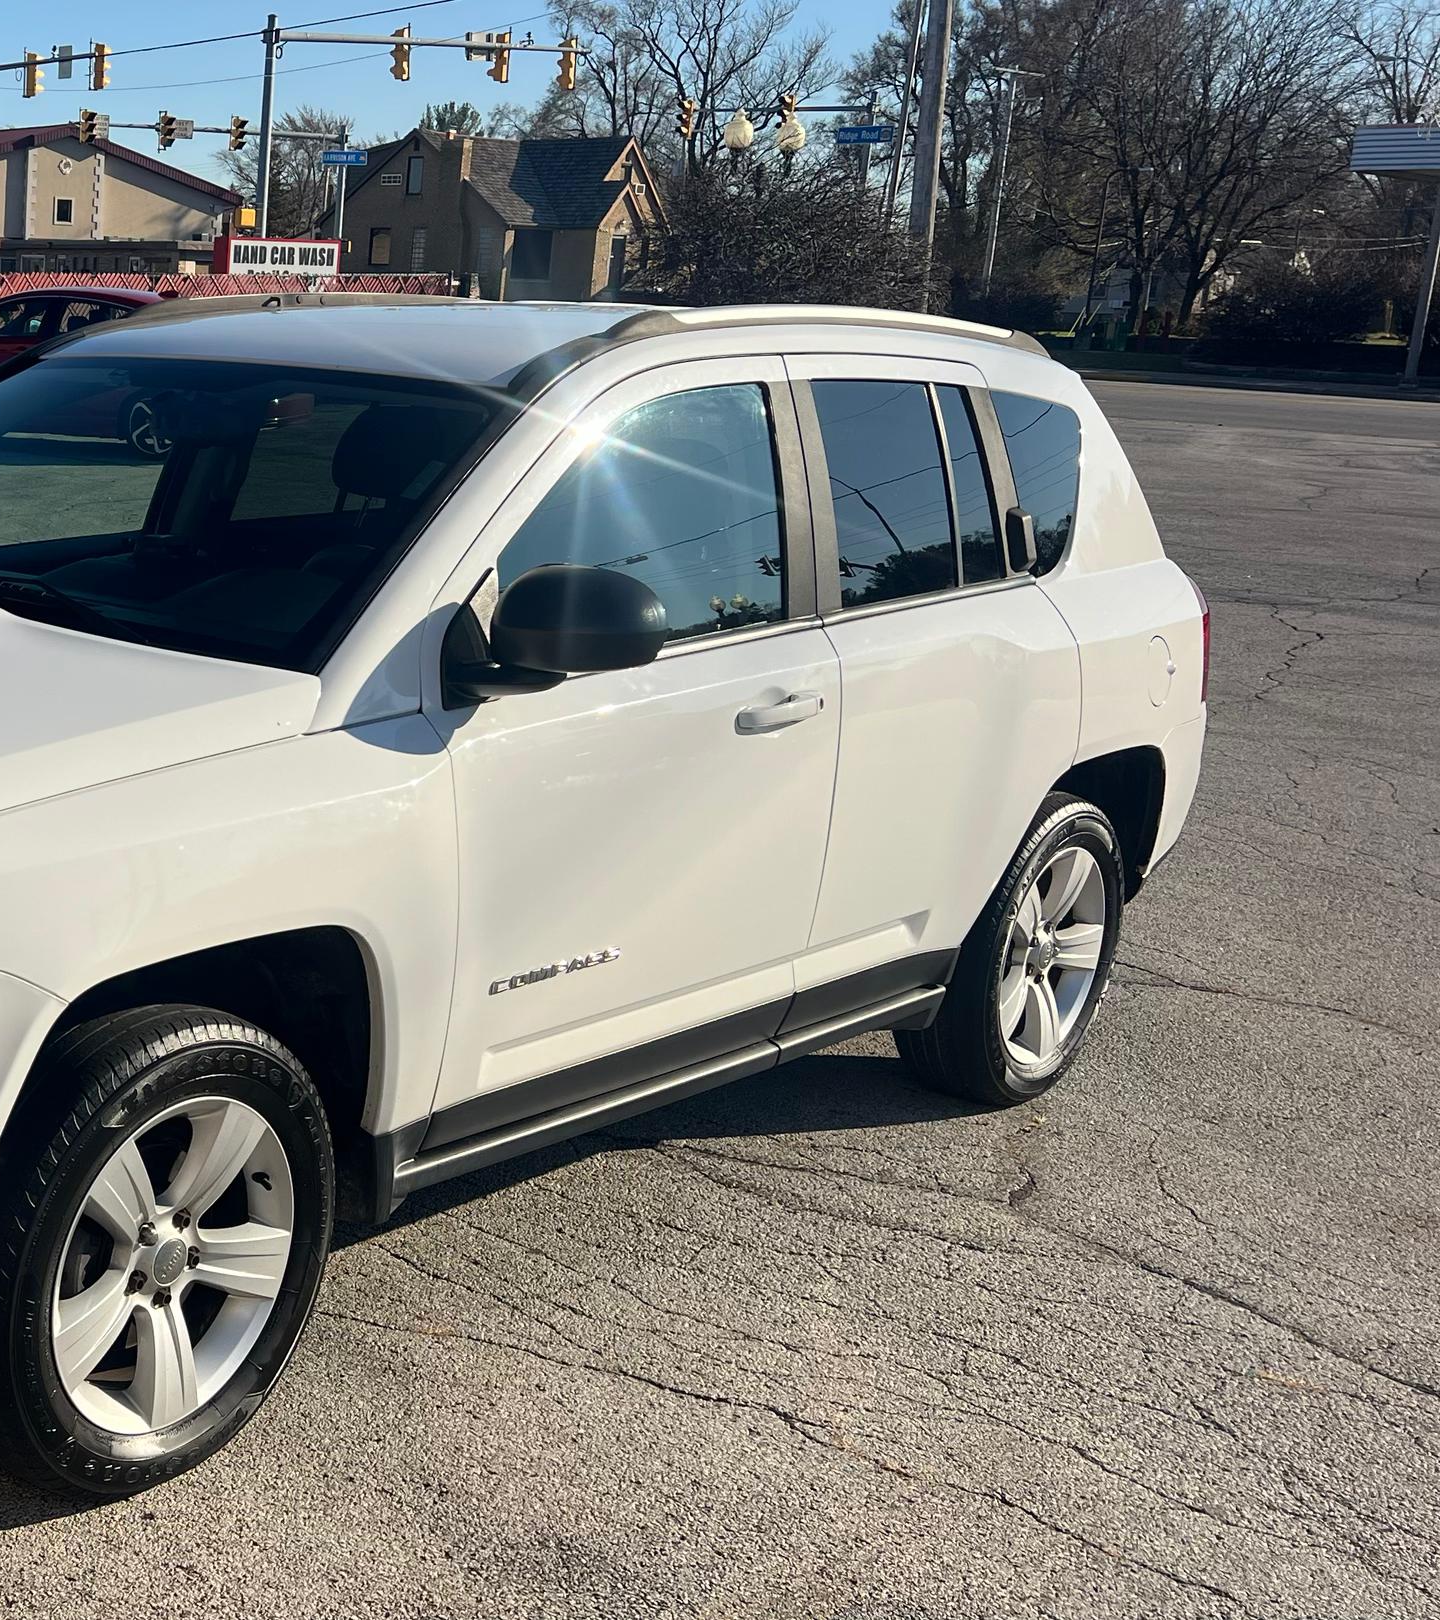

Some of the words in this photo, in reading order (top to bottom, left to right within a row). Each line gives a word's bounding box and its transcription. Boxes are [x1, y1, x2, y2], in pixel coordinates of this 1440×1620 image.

[839, 131, 859, 142] Ridge
[861, 130, 879, 140] Road
[233, 244, 267, 265] HAND
[270, 246, 295, 266] CAR
[298, 247, 335, 267] WASH
[488, 945, 621, 996] COMPASS
